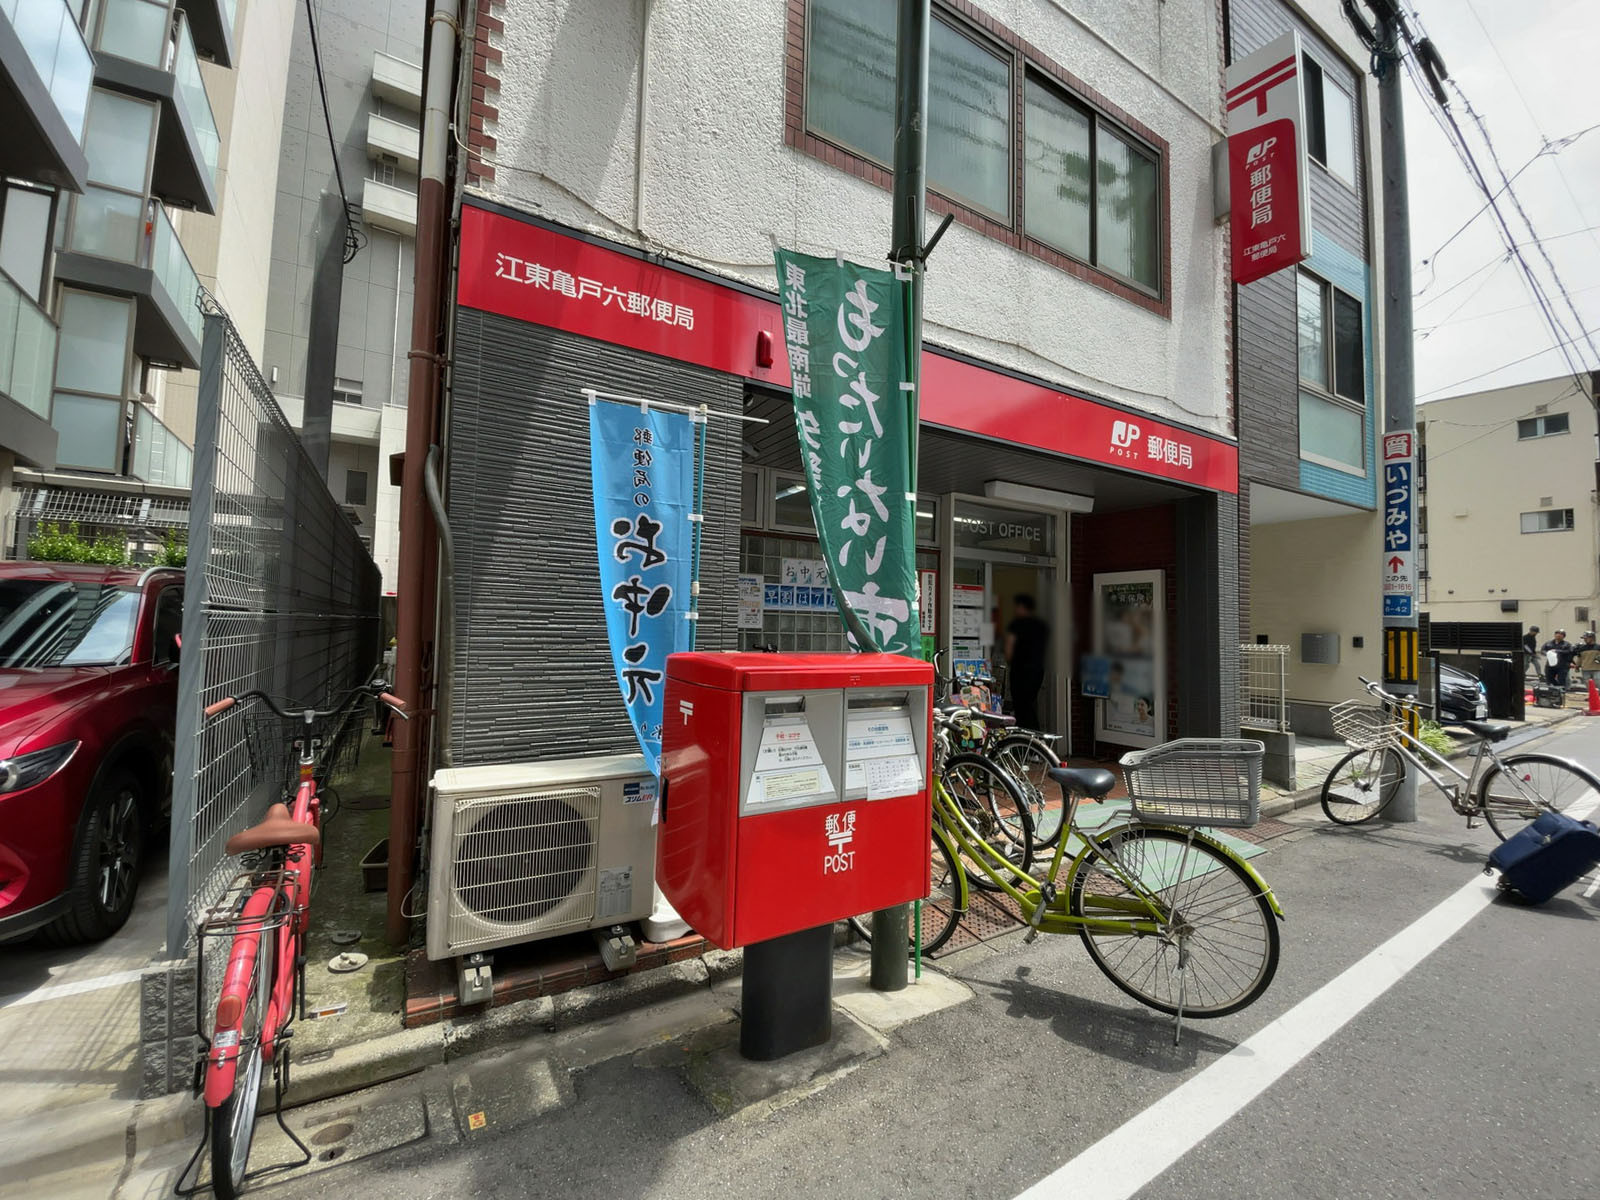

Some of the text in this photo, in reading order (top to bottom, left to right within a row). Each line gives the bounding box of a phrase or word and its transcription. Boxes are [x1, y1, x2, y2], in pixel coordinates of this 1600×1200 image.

[1245, 152, 1276, 170] POST
[1250, 163, 1273, 230] 郵便局
[1243, 233, 1287, 256] 江東亀戸六
[1251, 245, 1277, 262] 郵便局
[495, 252, 694, 331] 江東亀戸六郵便局
[1111, 420, 1141, 447] JP
[1110, 446, 1139, 459] POST
[1147, 435, 1193, 469] 郵便局
[1386, 466, 1408, 549] いづみや
[961, 519, 1041, 542] POST OFFICE
[786, 566, 828, 580] お中元
[825, 810, 857, 836] 郵便
[824, 851, 856, 875] POST
